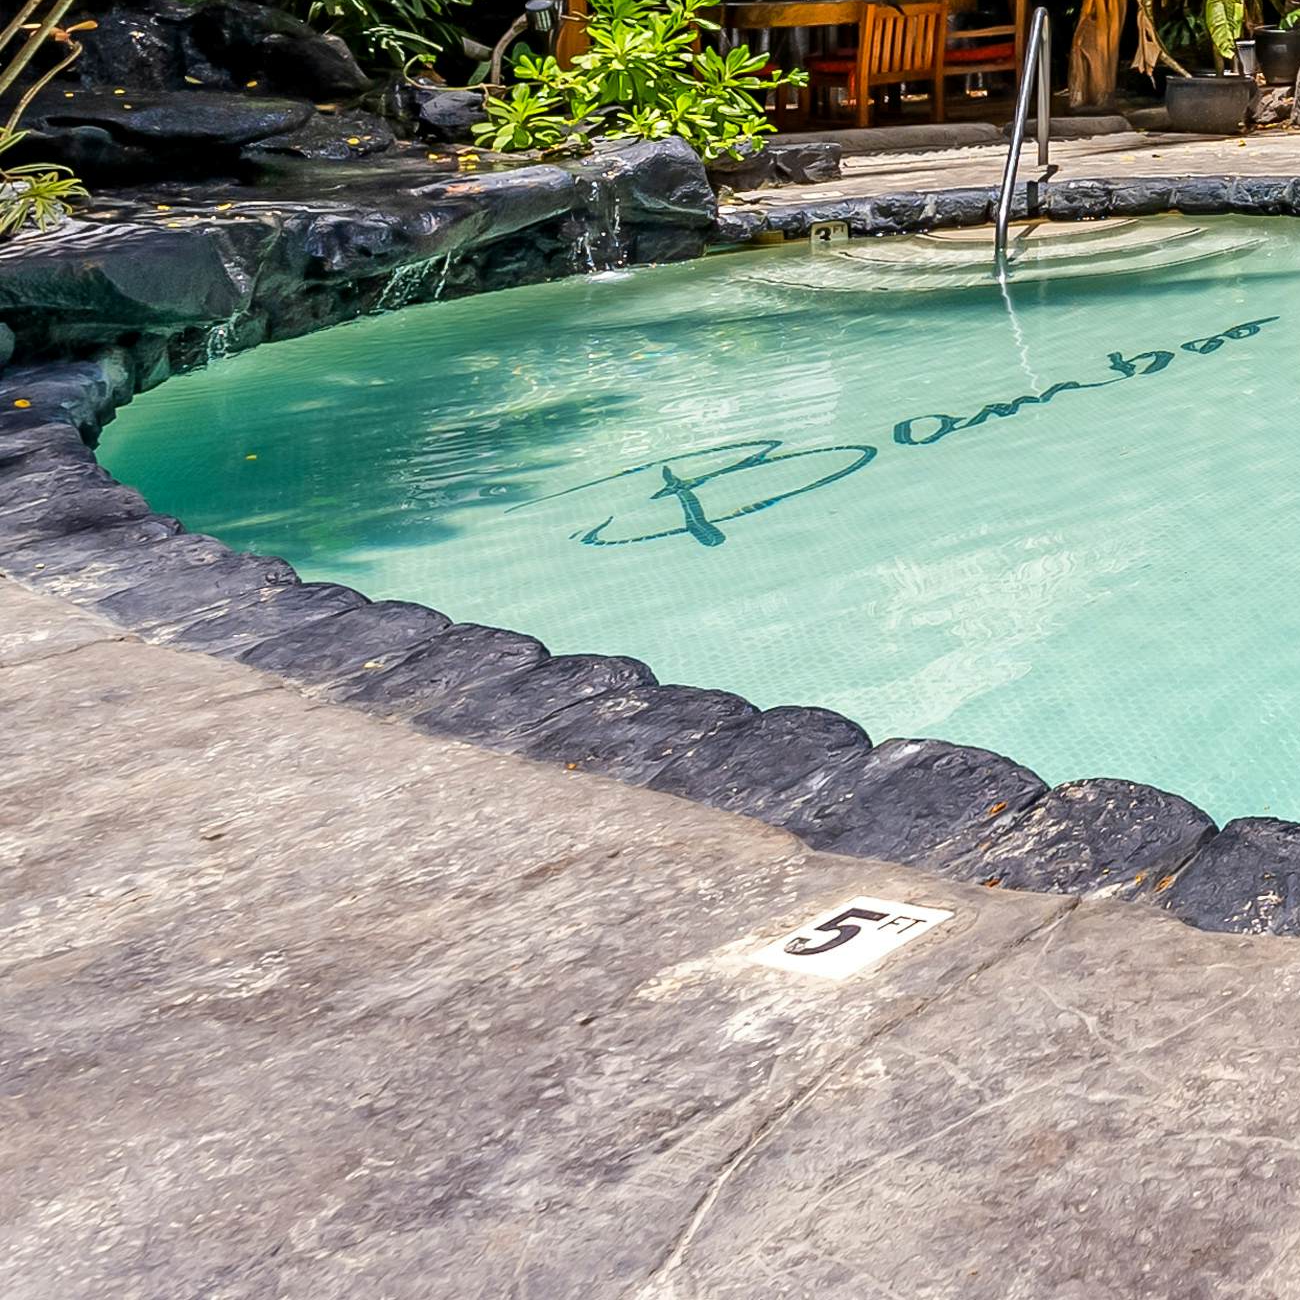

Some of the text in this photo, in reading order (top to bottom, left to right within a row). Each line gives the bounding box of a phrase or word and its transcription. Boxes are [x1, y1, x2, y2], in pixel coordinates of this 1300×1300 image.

[833, 224, 846, 234] FT
[504, 316, 1280, 547] Bamboo
[784, 908, 927, 955] 5 FT
